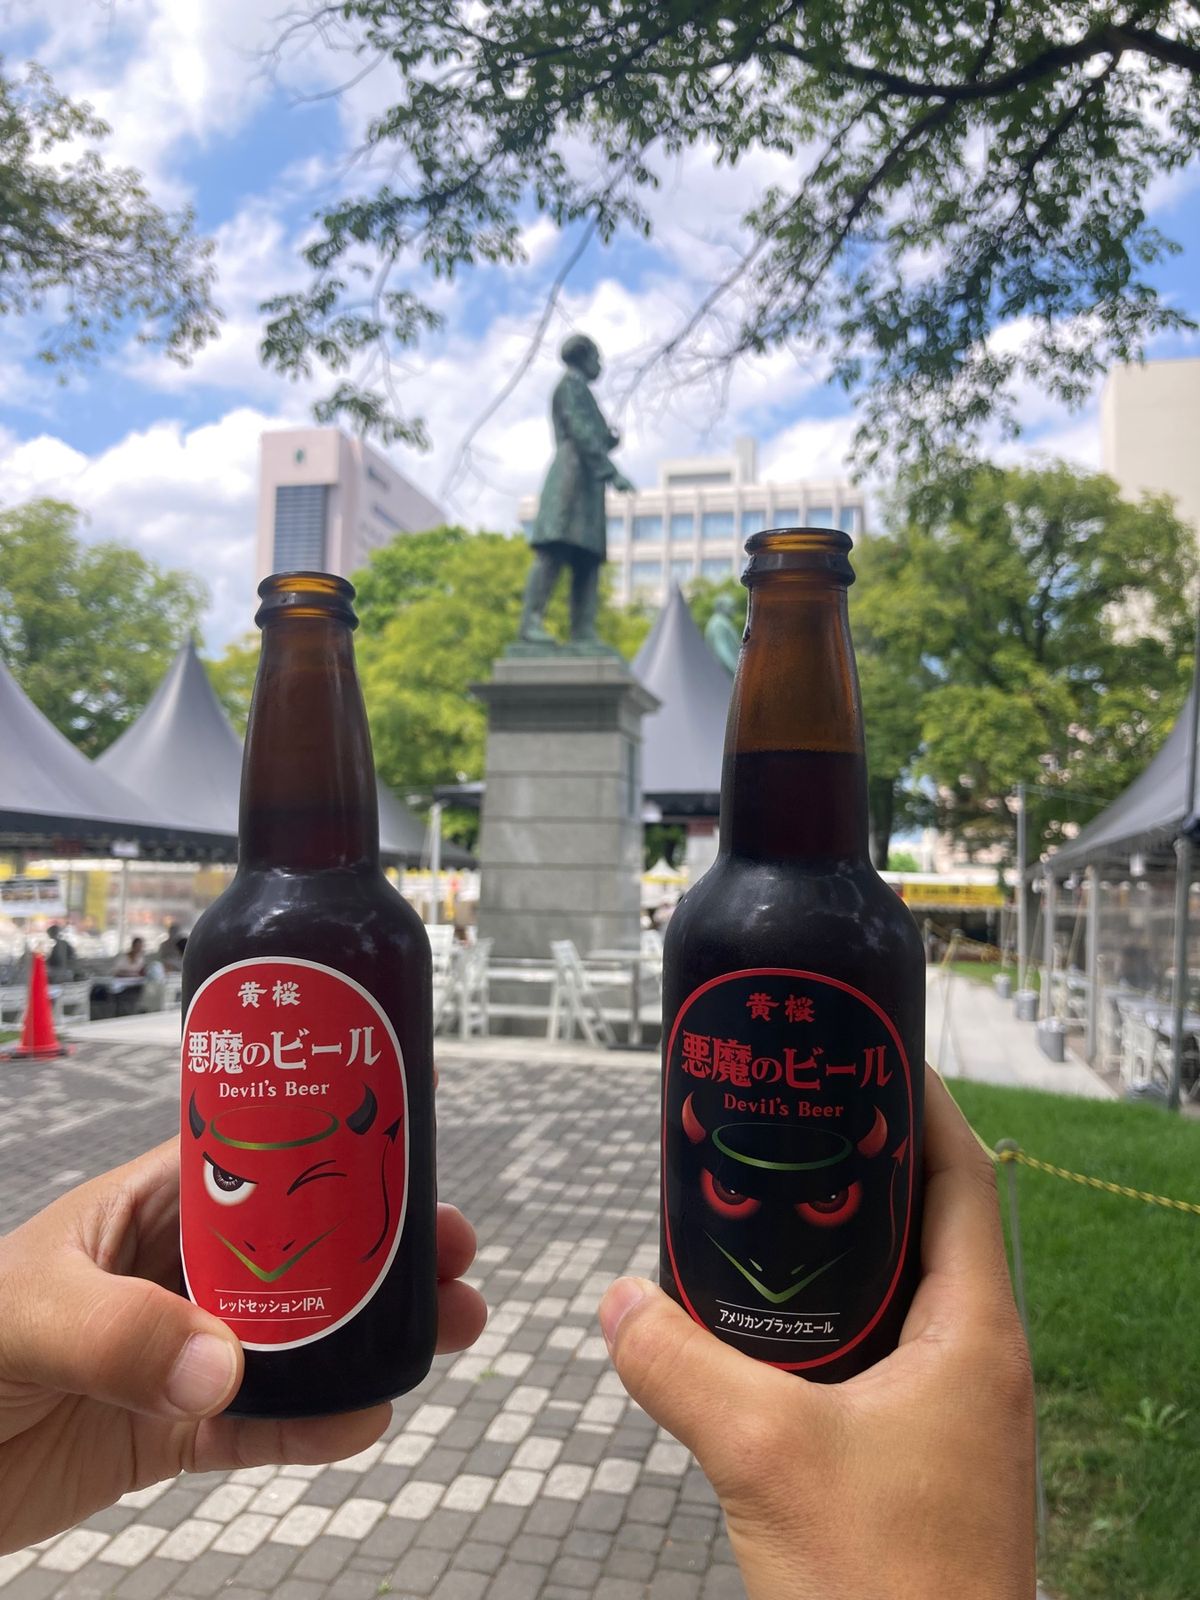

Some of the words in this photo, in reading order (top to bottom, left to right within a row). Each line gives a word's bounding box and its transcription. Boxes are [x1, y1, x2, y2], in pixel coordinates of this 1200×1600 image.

[237, 980, 301, 1008] 黄桜
[745, 992, 816, 1023] 黄桜
[188, 1026, 382, 1075] 悪魔のビール
[681, 1029, 893, 1090] 悪魔のビール
[219, 1080, 277, 1098] Devil's
[285, 1081, 330, 1097] Beer
[724, 1093, 790, 1116] Devil's
[798, 1101, 844, 1117] Beer
[219, 1296, 325, 1313] レッドセッションIPA
[720, 1309, 834, 1334] アメリカンブラックエール
